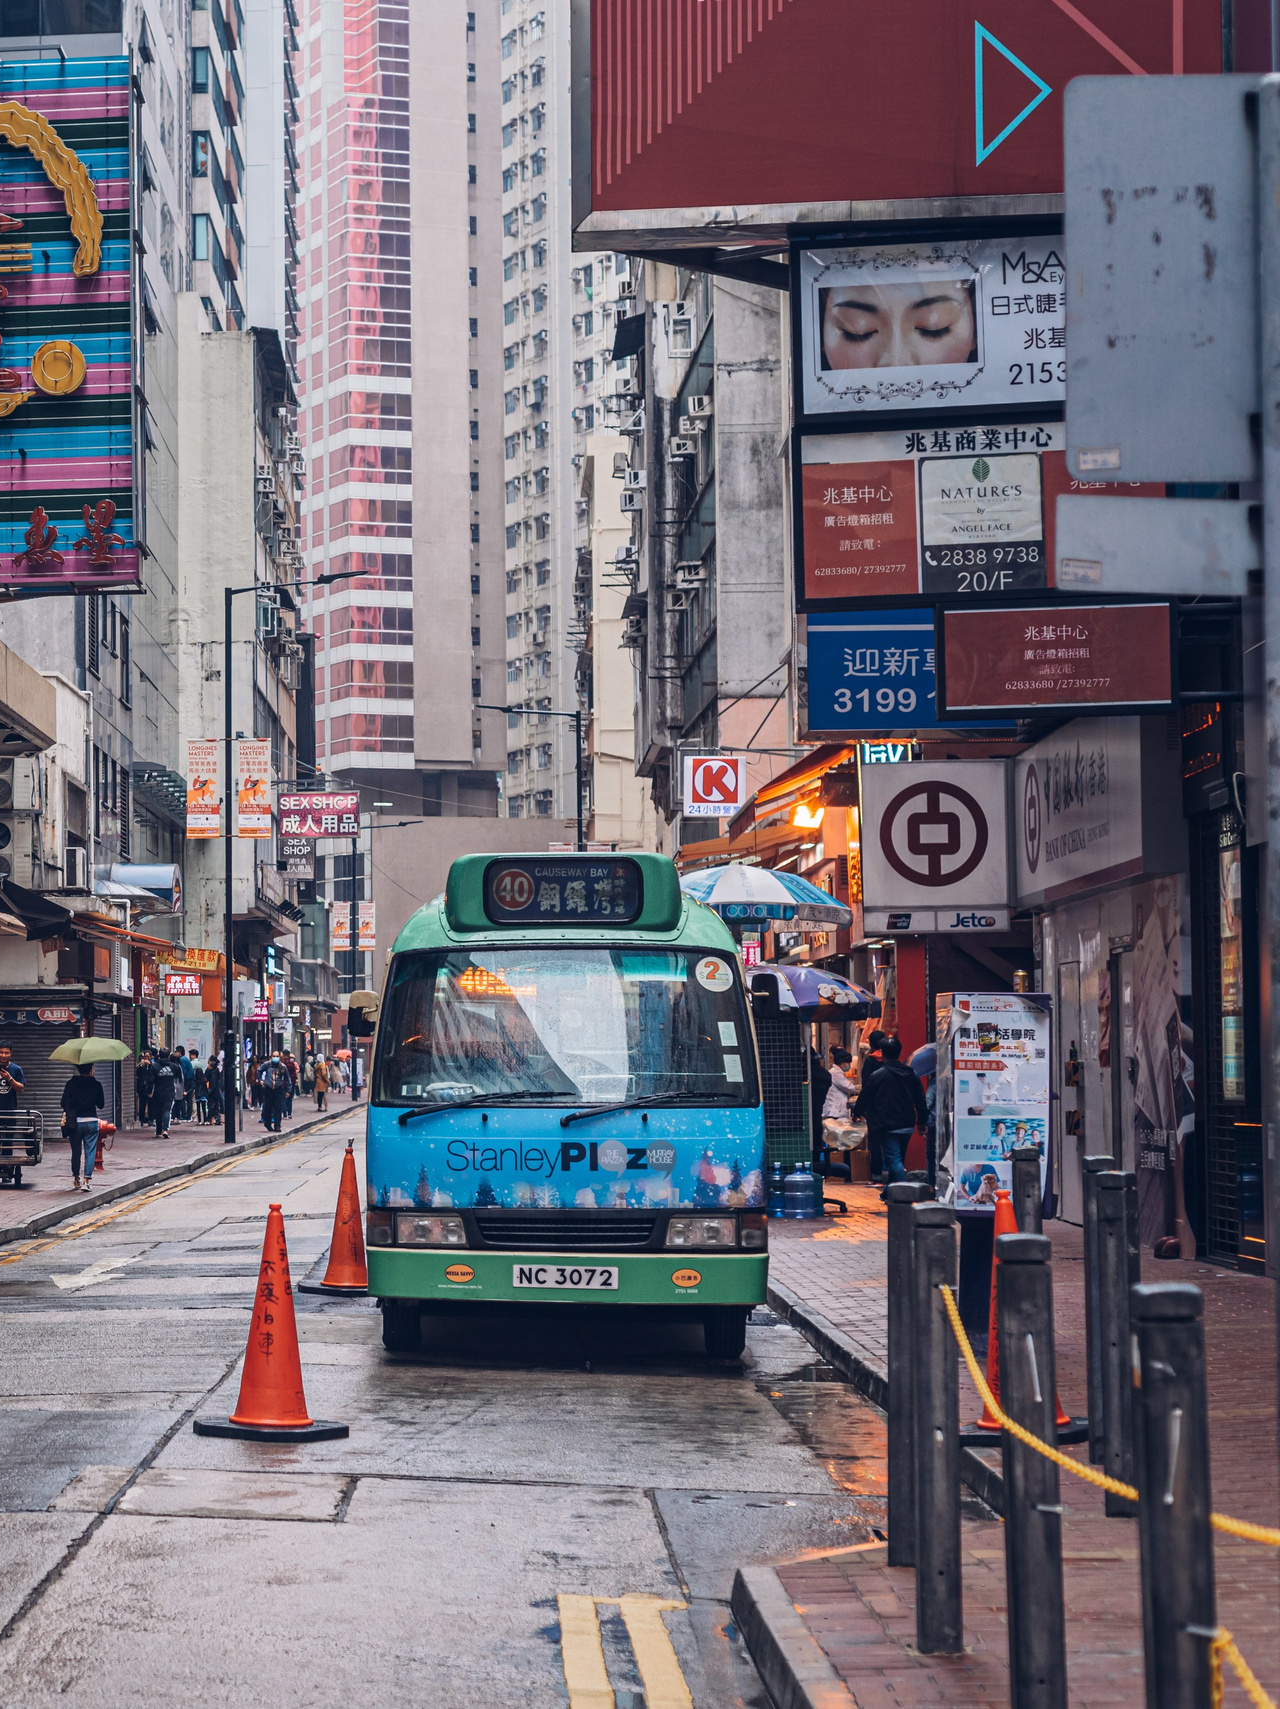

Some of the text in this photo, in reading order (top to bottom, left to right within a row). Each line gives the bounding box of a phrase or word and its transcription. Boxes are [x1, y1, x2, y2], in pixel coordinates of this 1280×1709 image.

[1009, 361, 1066, 386] 2153
[905, 427, 1053, 455] 兆基商業中心
[822, 485, 894, 506] 兆基中心
[976, 507, 986, 515] by
[824, 512, 895, 528] 廣告燈箱招租
[951, 522, 1013, 534] ANGEL FACE
[940, 546, 1039, 567] 2838 9738
[814, 564, 907, 577] 62833680/ 27392777
[957, 570, 1014, 593] 20/F
[1024, 624, 1089, 641] 兆基中心
[1024, 647, 1090, 661] 廣告燈箱招租
[1005, 679, 1054, 690] 62833680
[833, 687, 917, 714] 3199
[280, 795, 358, 811] SEX SHOP
[281, 813, 359, 835] 成人用品
[1067, 828, 1086, 855] CHINA
[283, 846, 311, 855] SHOP
[535, 867, 609, 878] CAUSEWAY BAY
[499, 876, 529, 902] 40
[537, 879, 614, 914] 銅鑼灣
[950, 912, 997, 928] Jetco
[959, 1028, 1037, 1042] 青活學院
[647, 1149, 676, 1158] MURRAY
[649, 1156, 674, 1165] HOUSE
[519, 1267, 613, 1287] NC 3072
